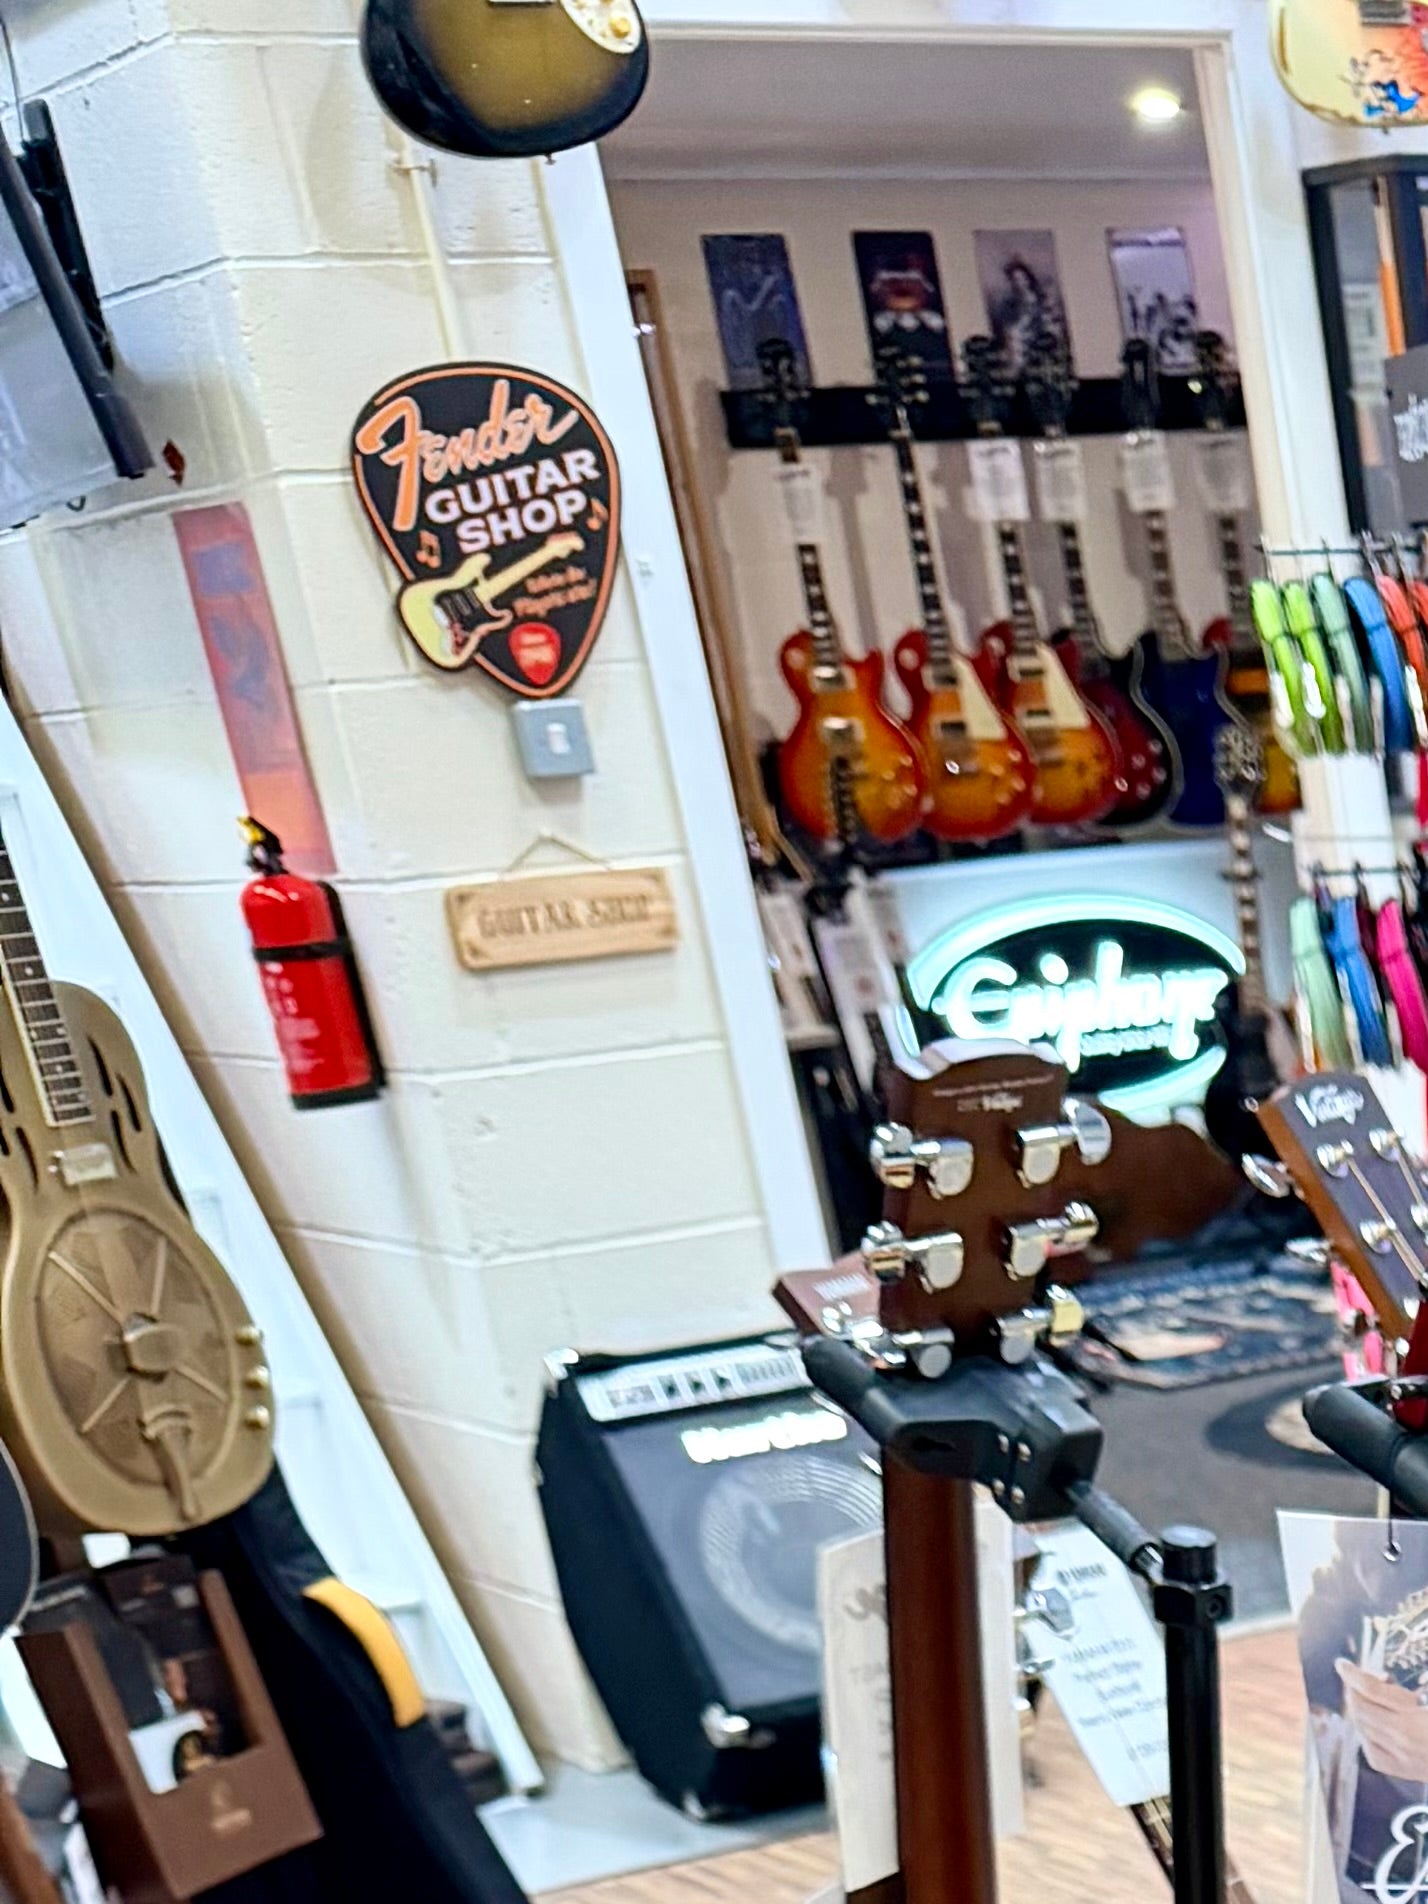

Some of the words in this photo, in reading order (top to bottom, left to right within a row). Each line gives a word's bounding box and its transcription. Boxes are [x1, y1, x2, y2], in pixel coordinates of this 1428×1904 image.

[355, 378, 580, 531] Fender
[424, 448, 601, 524] GUITAR
[455, 489, 588, 554] SHOP
[931, 940, 1229, 1074] Epiphone
